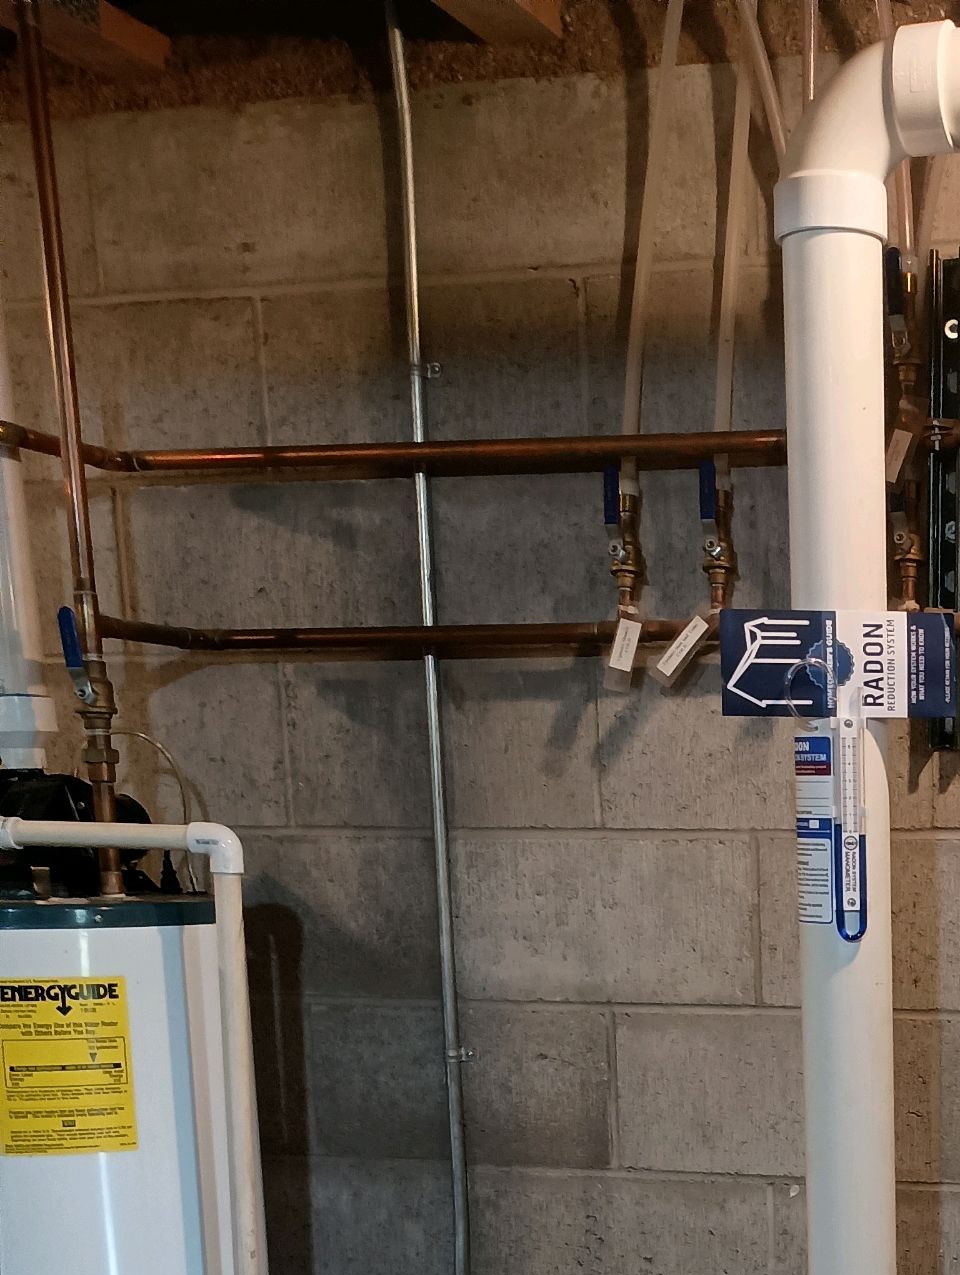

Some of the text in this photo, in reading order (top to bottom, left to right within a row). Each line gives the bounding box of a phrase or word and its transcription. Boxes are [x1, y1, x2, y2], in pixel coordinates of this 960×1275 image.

[862, 623, 884, 707] RADON
[886, 619, 896, 711] REDUCTION SYSTEM
